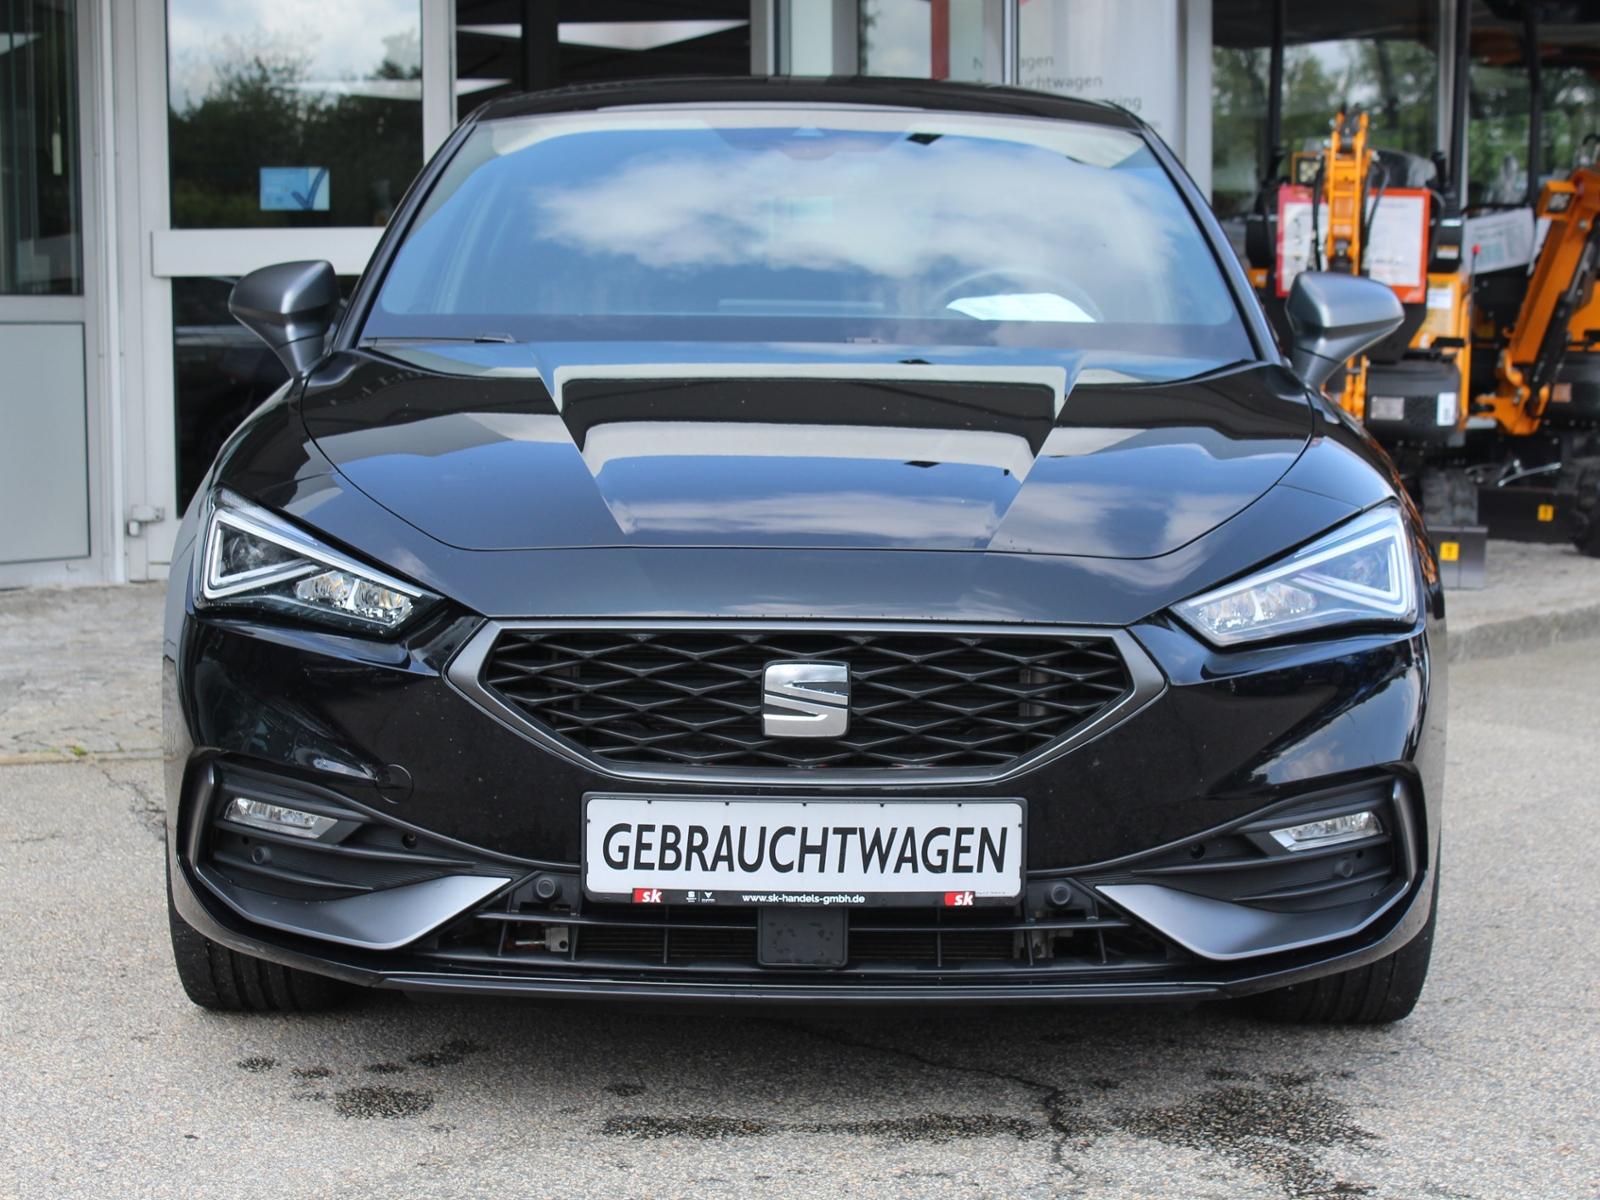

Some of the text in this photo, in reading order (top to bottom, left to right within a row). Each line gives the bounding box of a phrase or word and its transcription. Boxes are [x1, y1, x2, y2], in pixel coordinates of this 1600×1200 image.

[602, 823, 1008, 874] GEBRAUCHTWAGEN
[641, 888, 662, 903] sk
[742, 892, 866, 905] www.sk-handels-gmbh.de
[953, 892, 975, 906] sk
